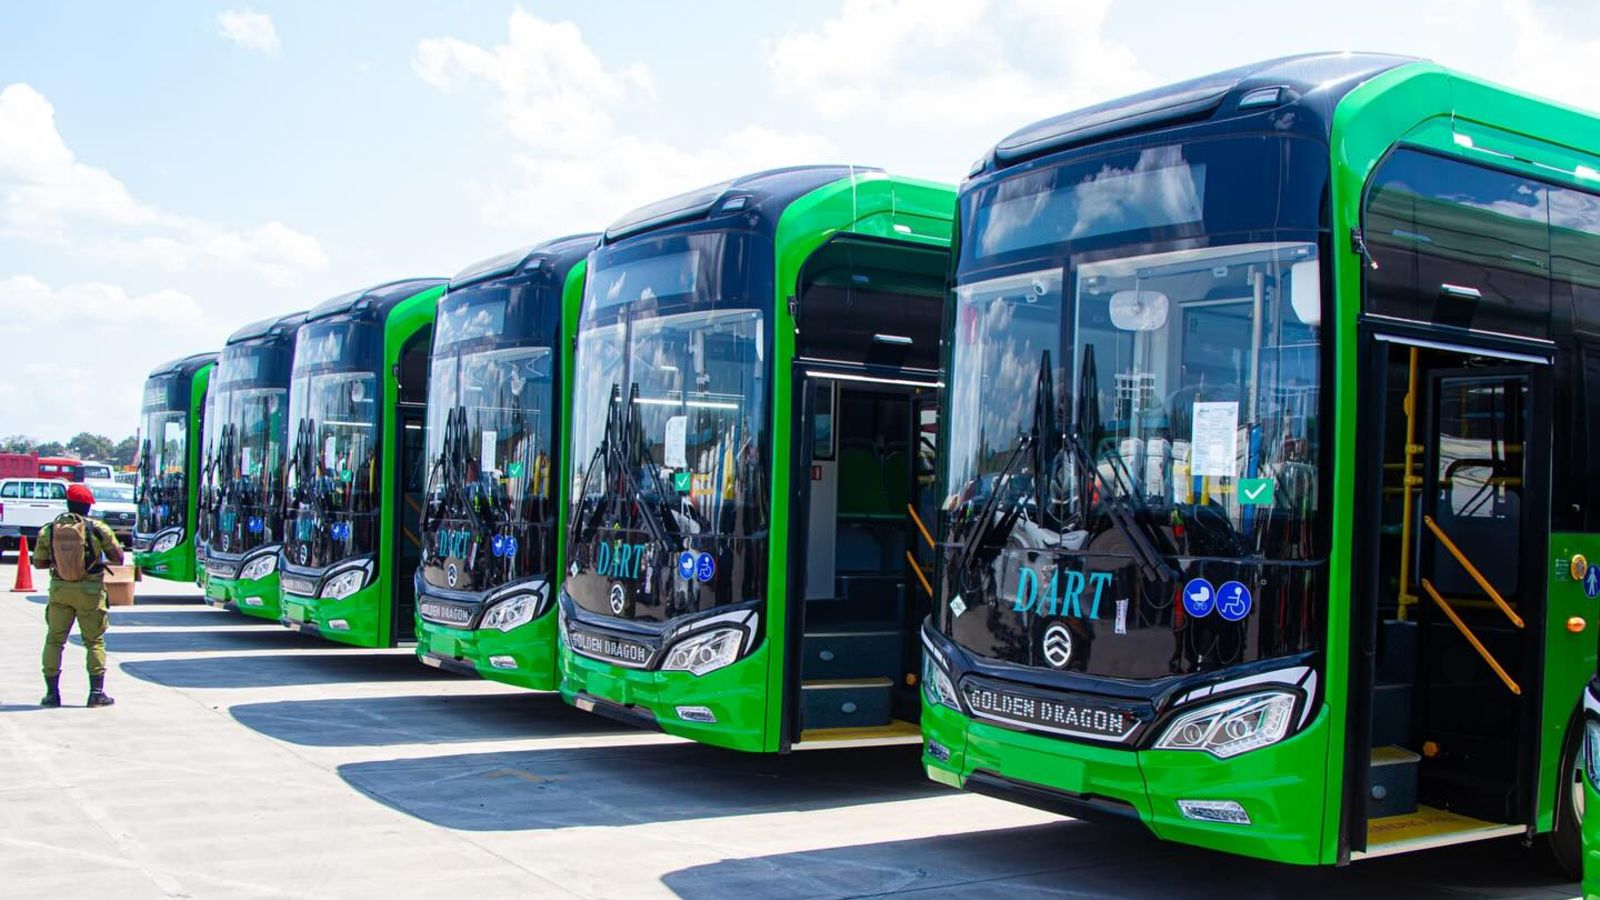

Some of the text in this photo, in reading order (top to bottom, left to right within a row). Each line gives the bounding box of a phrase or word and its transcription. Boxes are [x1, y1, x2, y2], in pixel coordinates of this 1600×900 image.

[597, 541, 645, 580] DART
[1013, 567, 1113, 620] DART
[604, 640, 645, 662] DRAGON
[971, 690, 1124, 734] GOLDEN DRAGON
